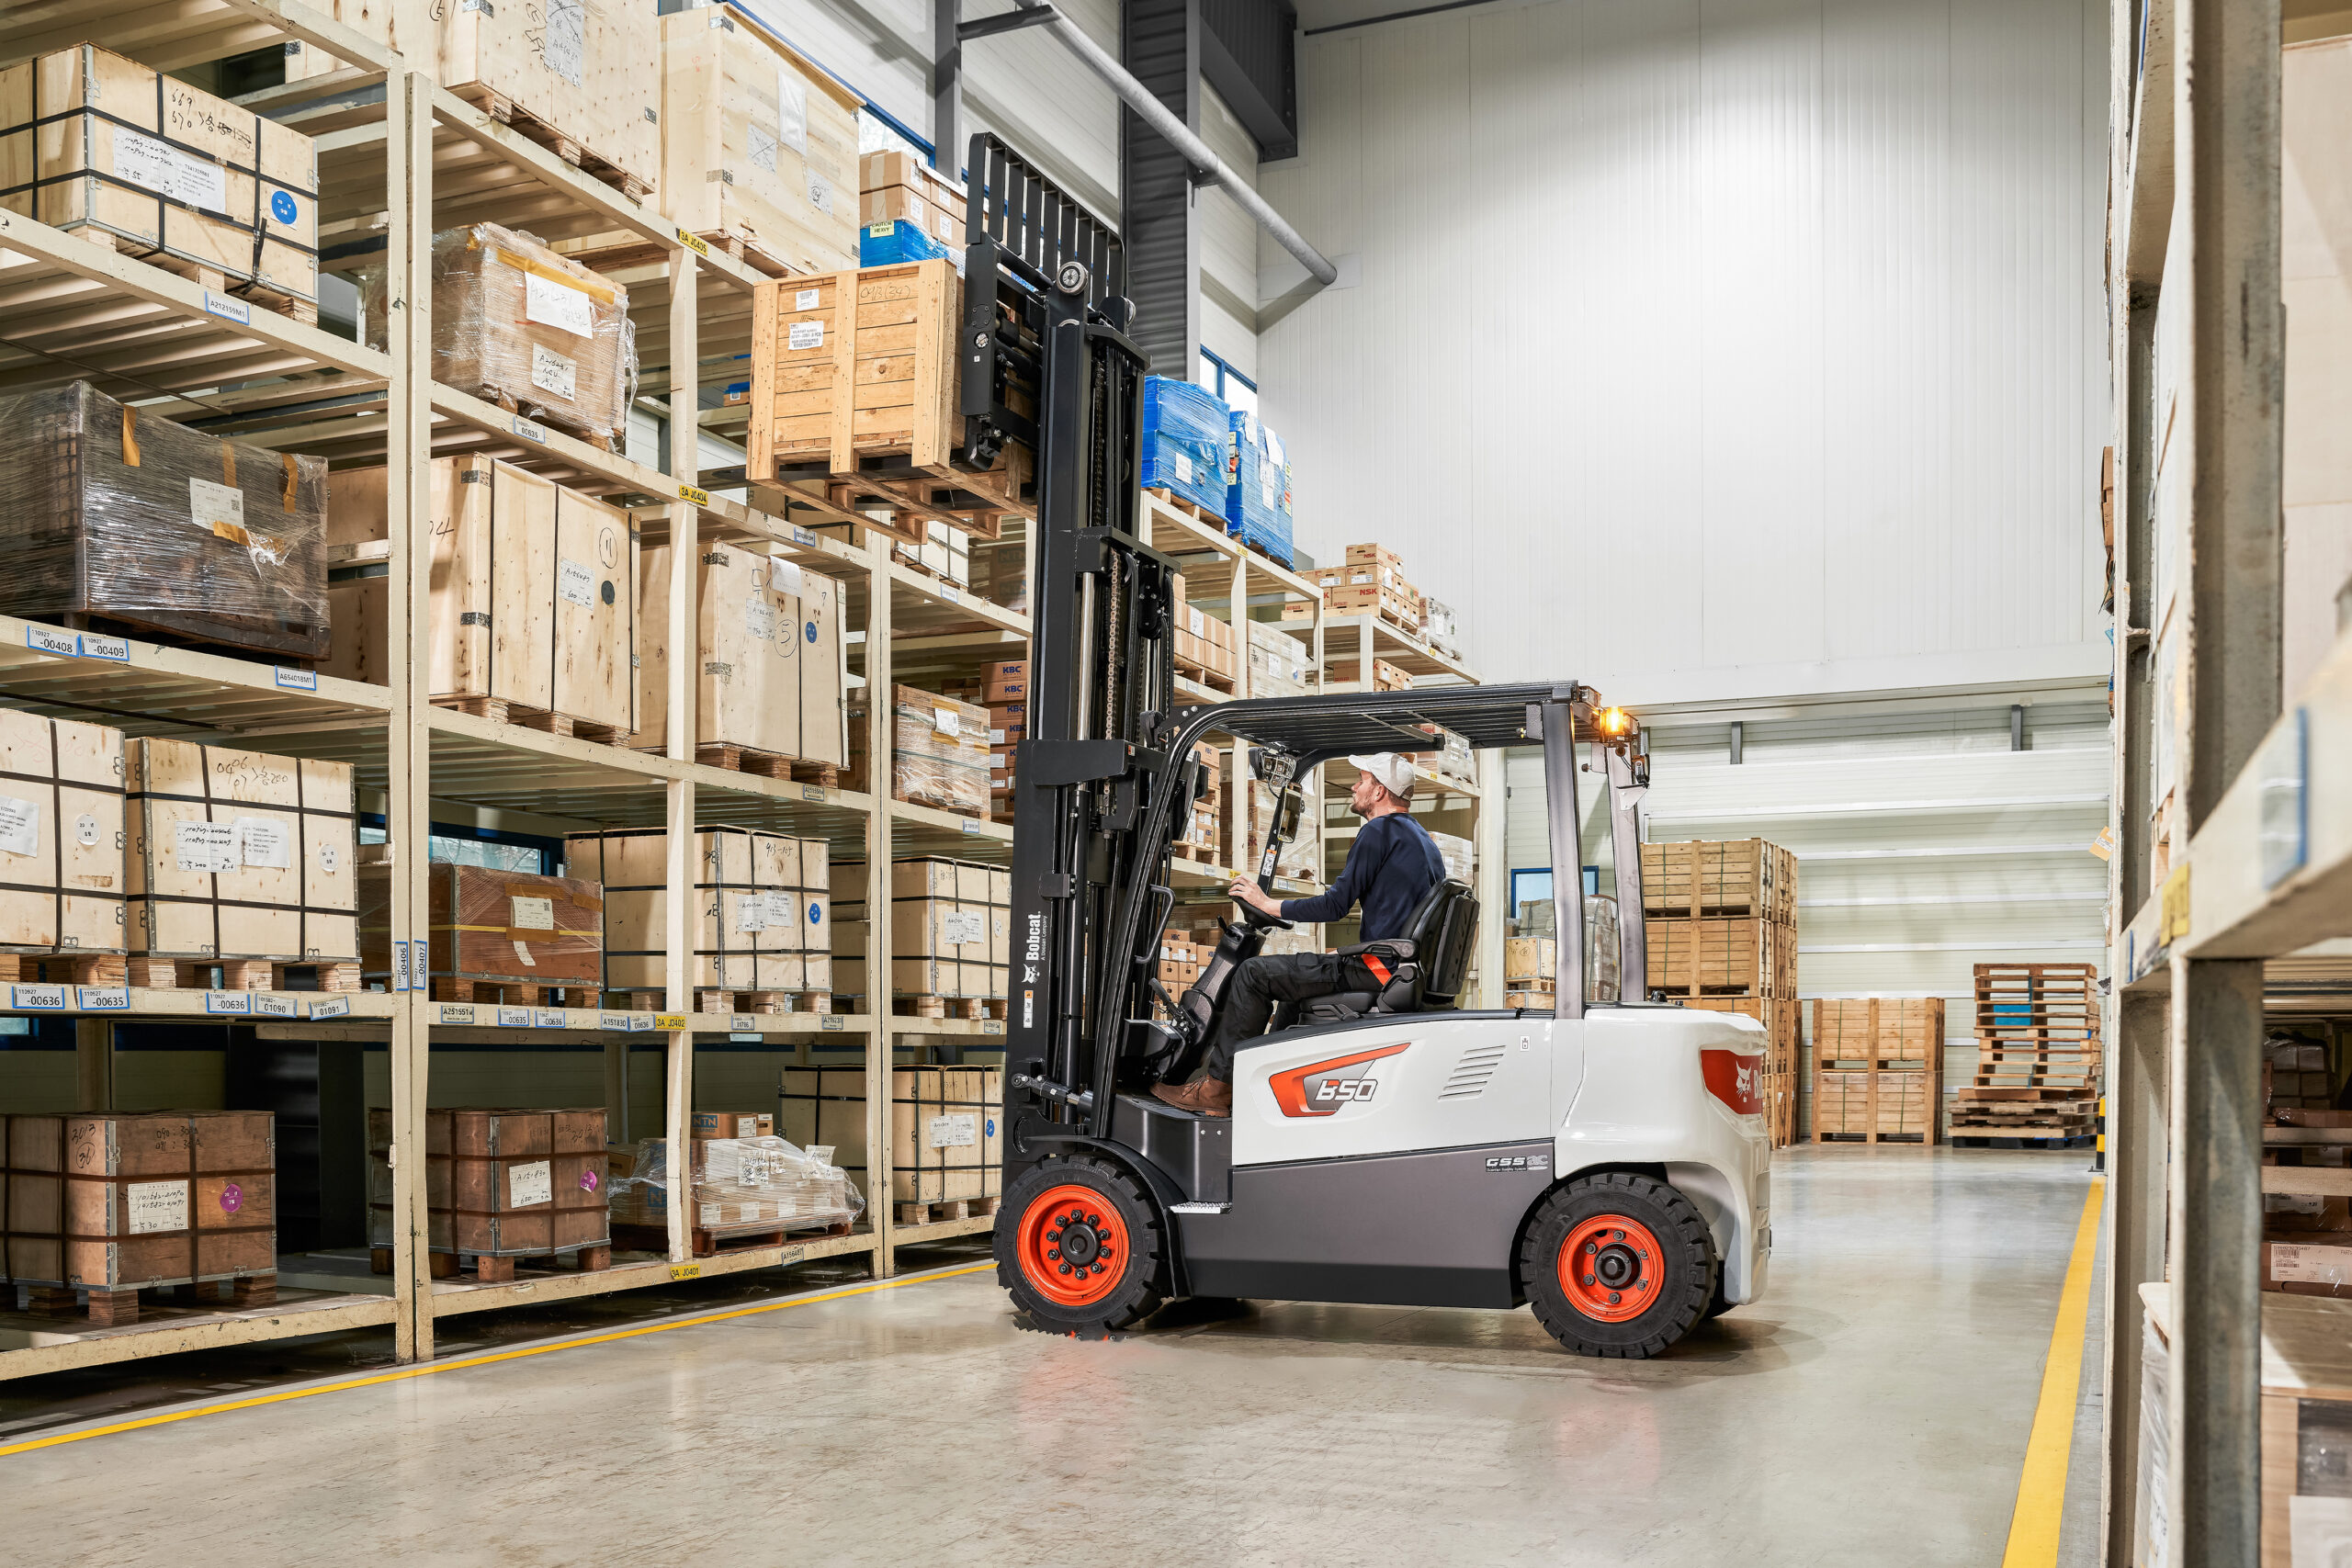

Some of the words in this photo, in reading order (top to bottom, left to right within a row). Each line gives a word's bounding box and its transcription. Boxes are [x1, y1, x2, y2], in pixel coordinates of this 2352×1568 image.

[681, 231, 689, 243] 3A
[681, 487, 688, 497] 3A
[40, 638, 73, 653] -00408
[93, 645, 125, 658] -00409
[1002, 666, 1022, 674] KBC
[1004, 685, 1023, 694] KBC
[1007, 705, 1025, 713] KBC
[1009, 724, 1027, 732] KBC
[1025, 914, 1041, 961] Bobcat
[27, 996, 61, 1006] -00636
[92, 998, 124, 1007] -00635
[217, 1000, 245, 1010] -00636
[264, 1003, 287, 1013] 01090
[319, 1006, 340, 1016] 01091
[657, 1019, 666, 1027] 3A
[667, 1019, 685, 1027] J0402
[693, 1114, 718, 1126] NTN
[1486, 1157, 1526, 1167] GSS
[672, 1269, 680, 1278] 3A
[683, 1268, 699, 1277] J0401
